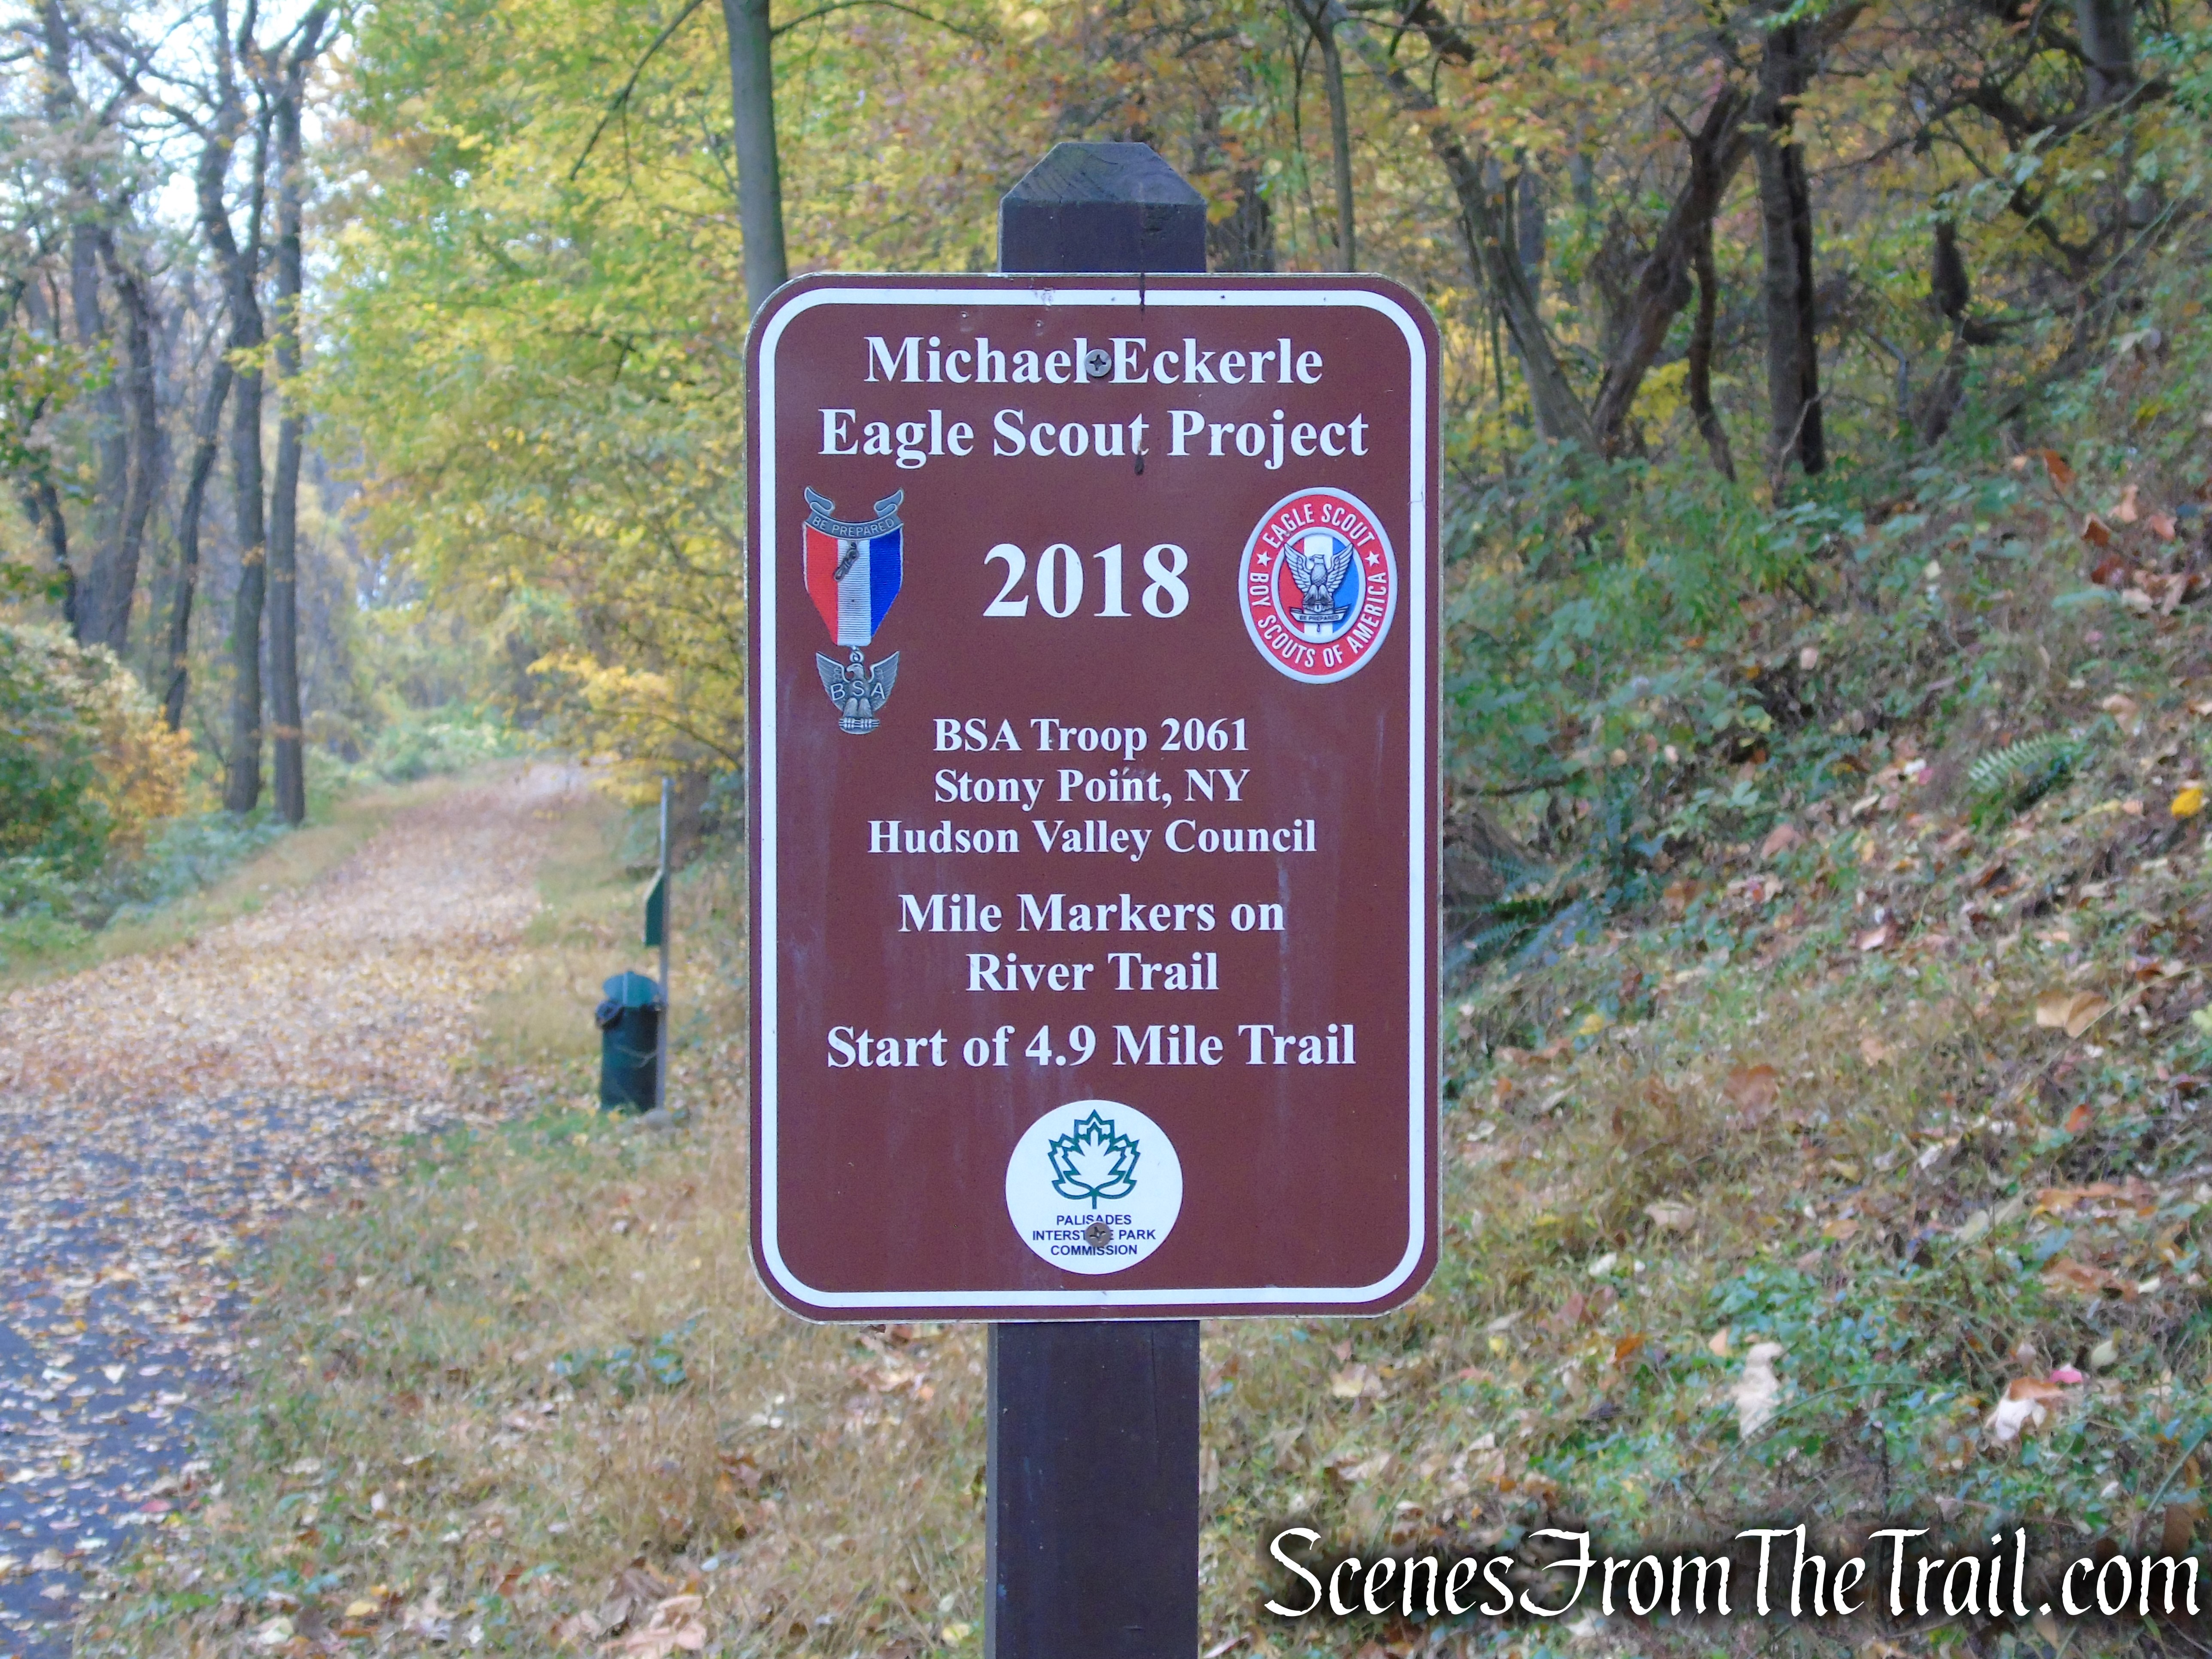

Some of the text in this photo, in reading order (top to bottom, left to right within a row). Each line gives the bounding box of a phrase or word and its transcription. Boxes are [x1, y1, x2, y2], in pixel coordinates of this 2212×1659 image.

[864, 337, 1322, 383] Michael Eckerle
[819, 409, 1368, 469] Eagle Scout Project
[812, 517, 894, 537] BE PREPARED
[1263, 503, 1376, 548] EAGLE SCOUT
[983, 544, 1188, 617] 2018
[1249, 571, 1387, 668] BOY SCOUTS OF AMERICA
[933, 718, 1248, 760] BSA Troop 2061
[936, 769, 1250, 811] Stony Point, NY
[869, 819, 1316, 861] Hudson Valley Council
[899, 894, 1285, 932] Mile Markers on
[966, 952, 1218, 991] River Trail
[829, 1024, 1355, 1067] Start of 4.9 Mile Trail
[1033, 1229, 1156, 1241] INTERSTE PARK
[1057, 1215, 1132, 1225] PALISADES
[1051, 1245, 1137, 1255] COMMISSION
